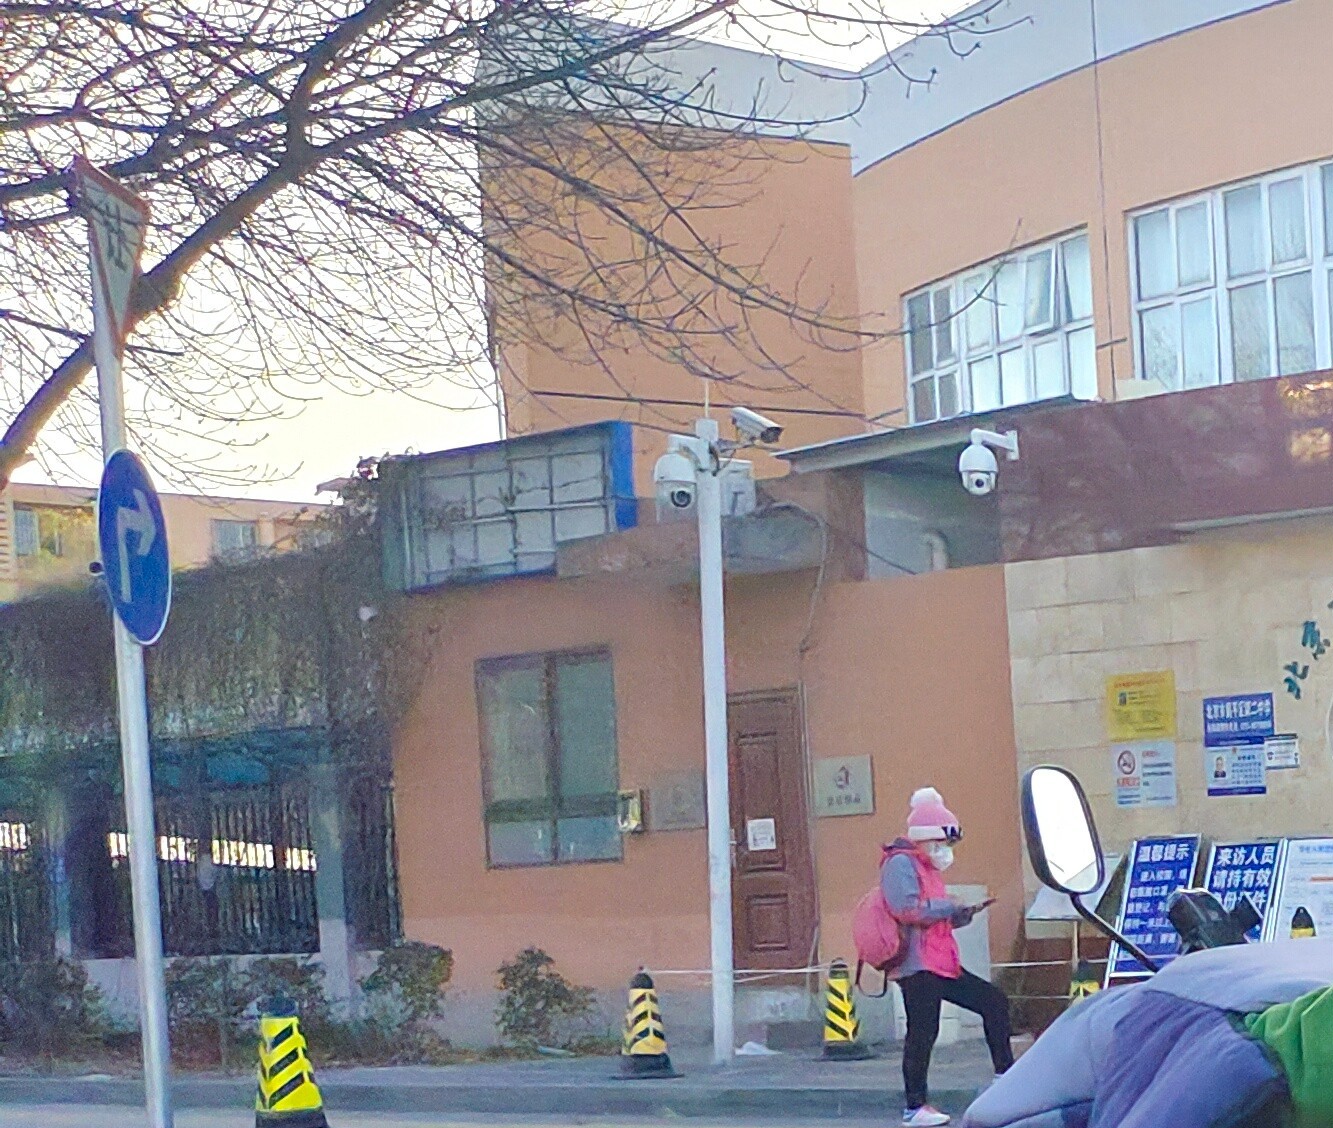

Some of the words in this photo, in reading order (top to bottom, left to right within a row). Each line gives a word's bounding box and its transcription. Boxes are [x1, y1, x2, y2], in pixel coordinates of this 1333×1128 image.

[1216, 845, 1276, 867] 来访人员
[1213, 868, 1272, 889] 请持有效
